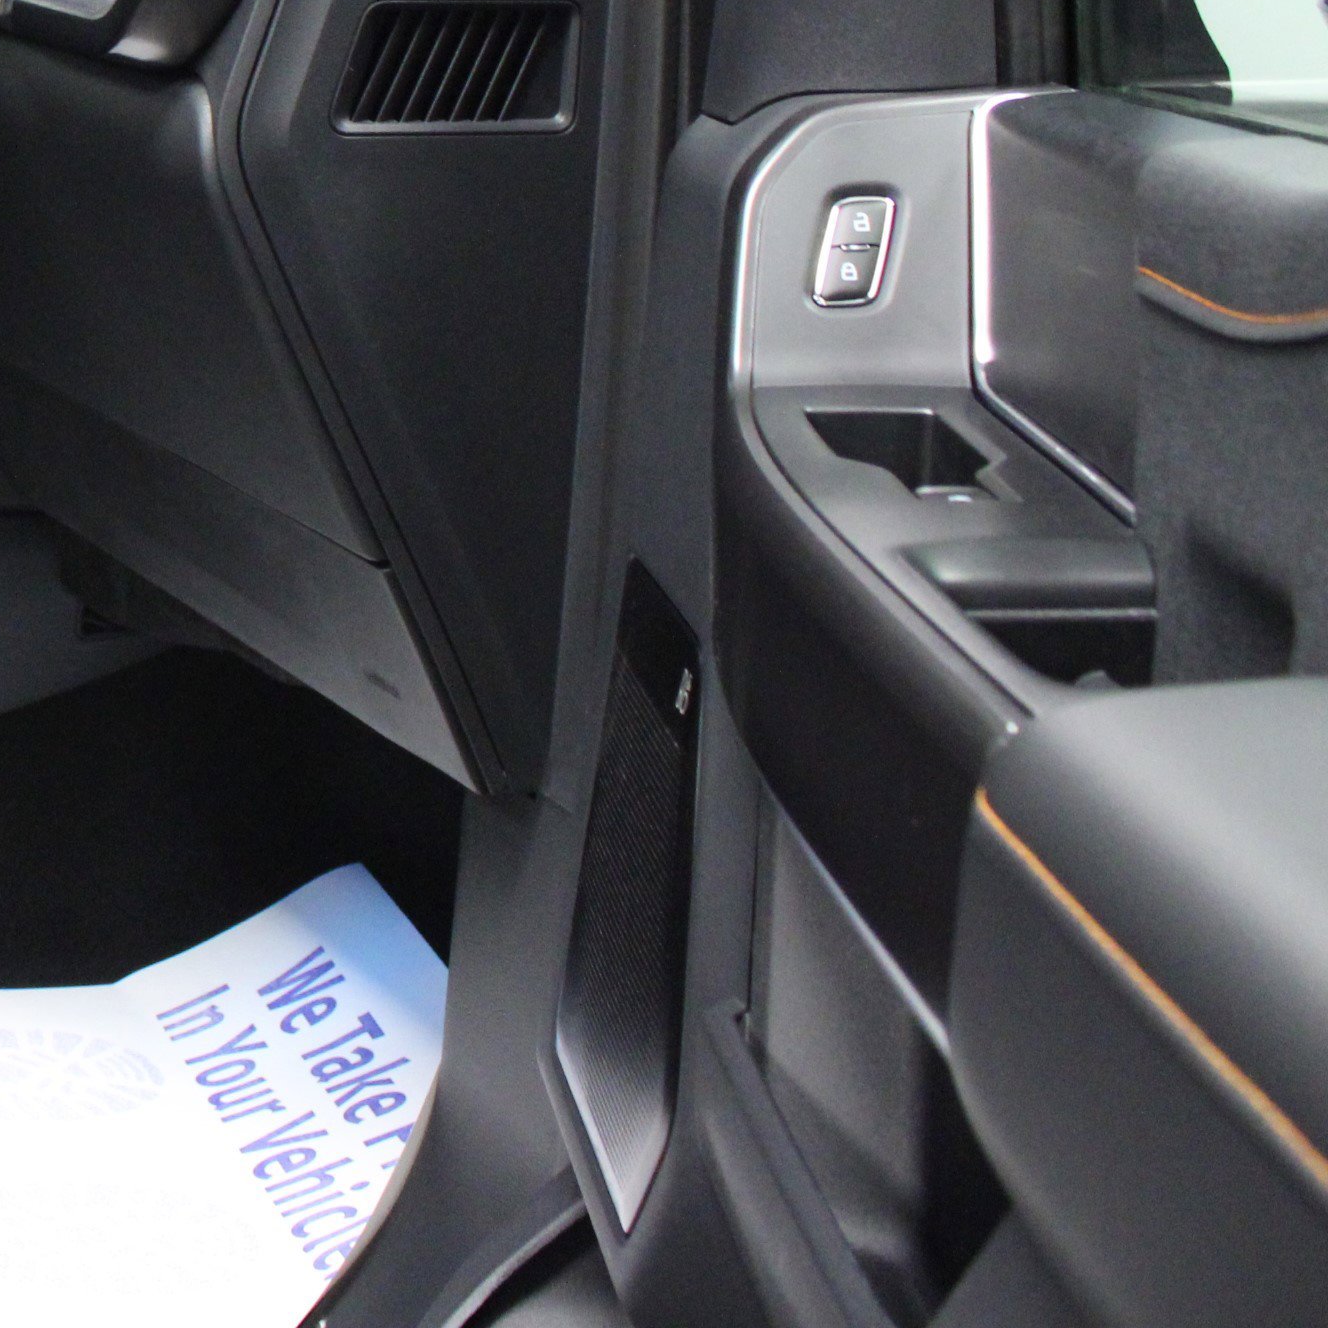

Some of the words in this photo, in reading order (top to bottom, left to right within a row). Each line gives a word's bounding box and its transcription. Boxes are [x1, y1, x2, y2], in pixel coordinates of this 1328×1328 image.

[156, 984, 230, 1041] In
[257, 946, 345, 1034] We
[301, 1012, 410, 1123] Take
[185, 1024, 286, 1122] Your
